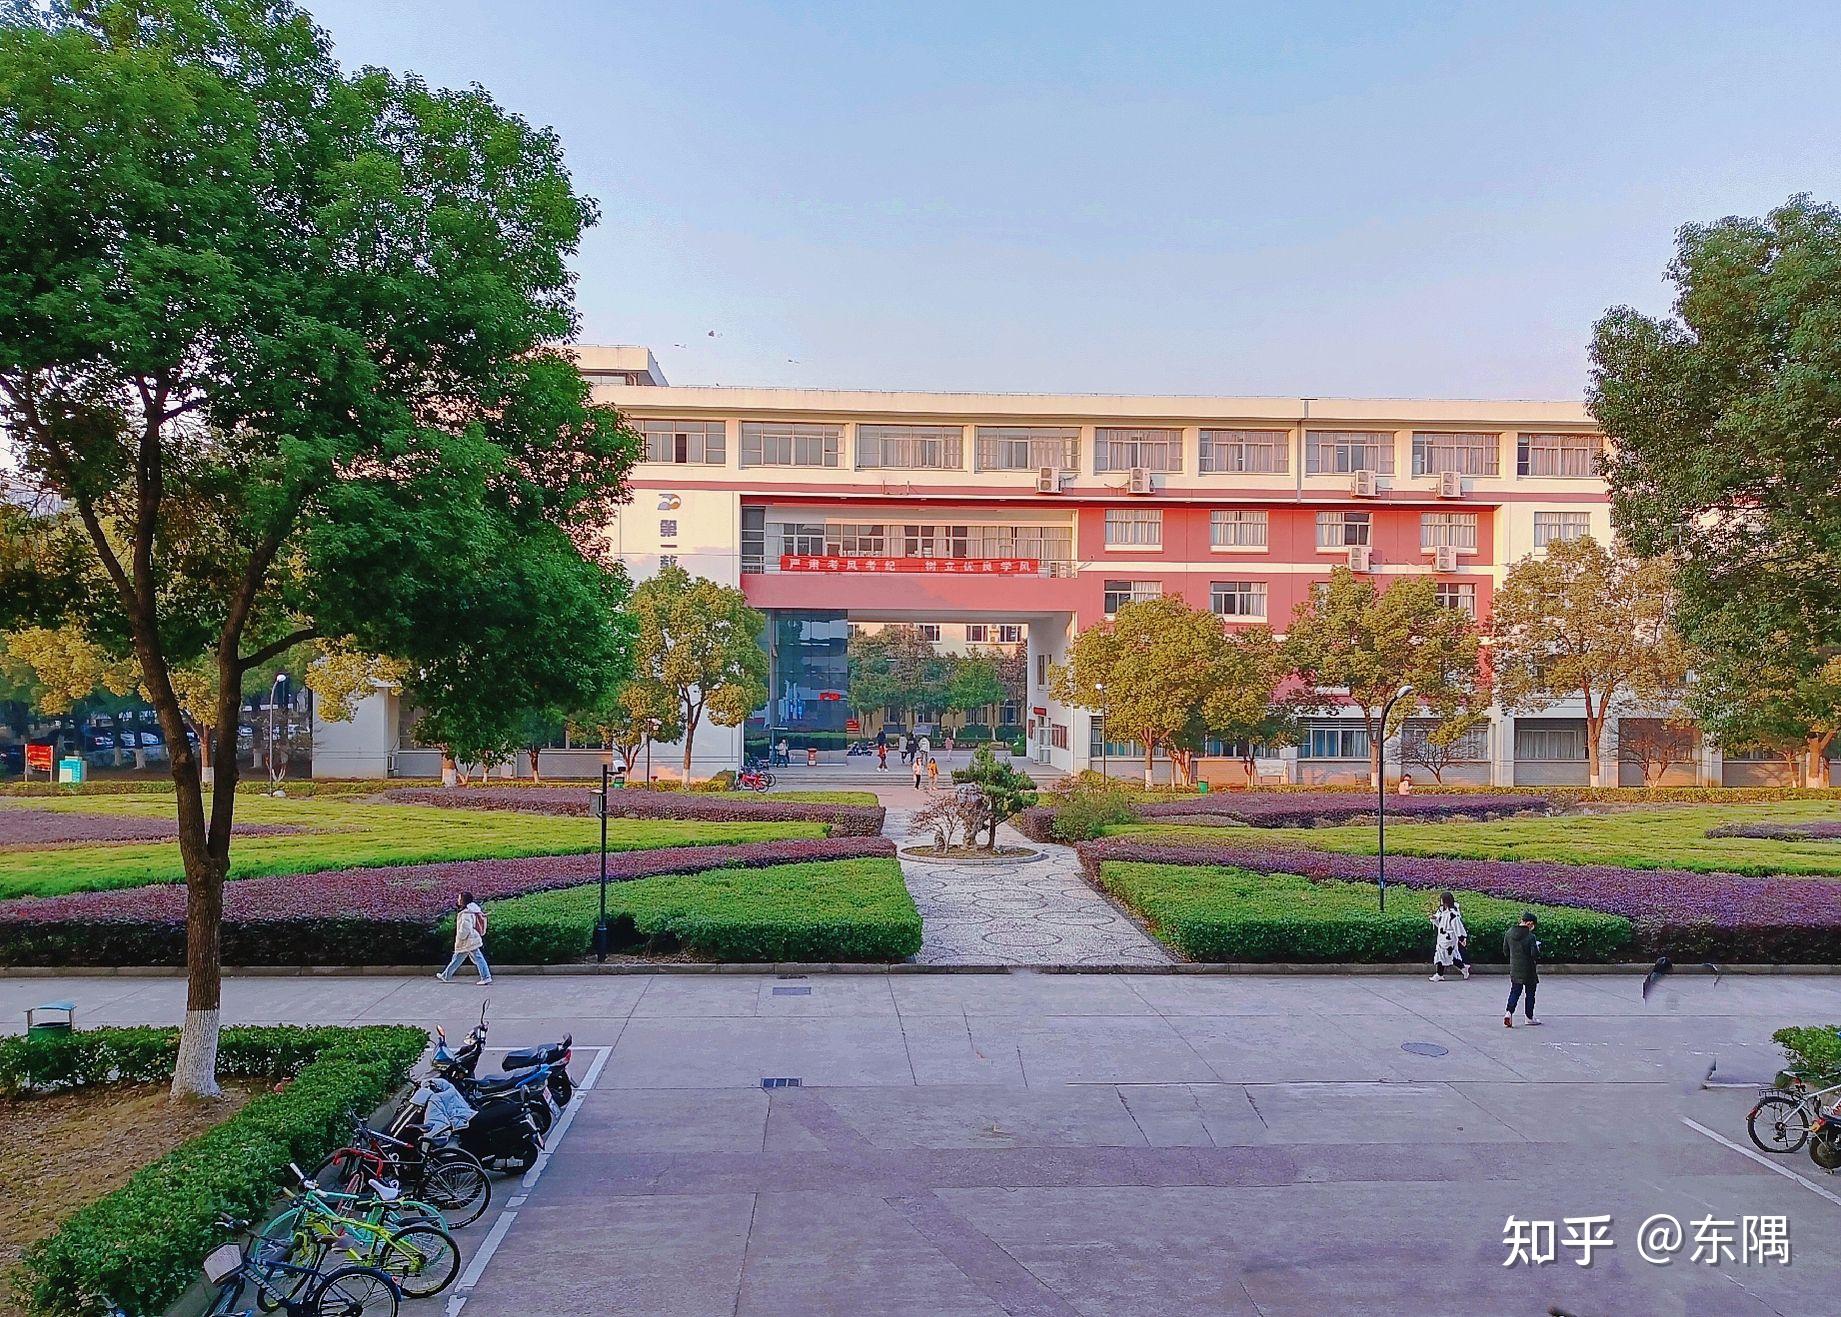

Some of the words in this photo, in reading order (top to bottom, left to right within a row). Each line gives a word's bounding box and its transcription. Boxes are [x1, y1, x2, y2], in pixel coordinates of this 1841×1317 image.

[788, 557, 897, 572] 严肃考风考纪
[924, 560, 1032, 573] 树立优良学风
